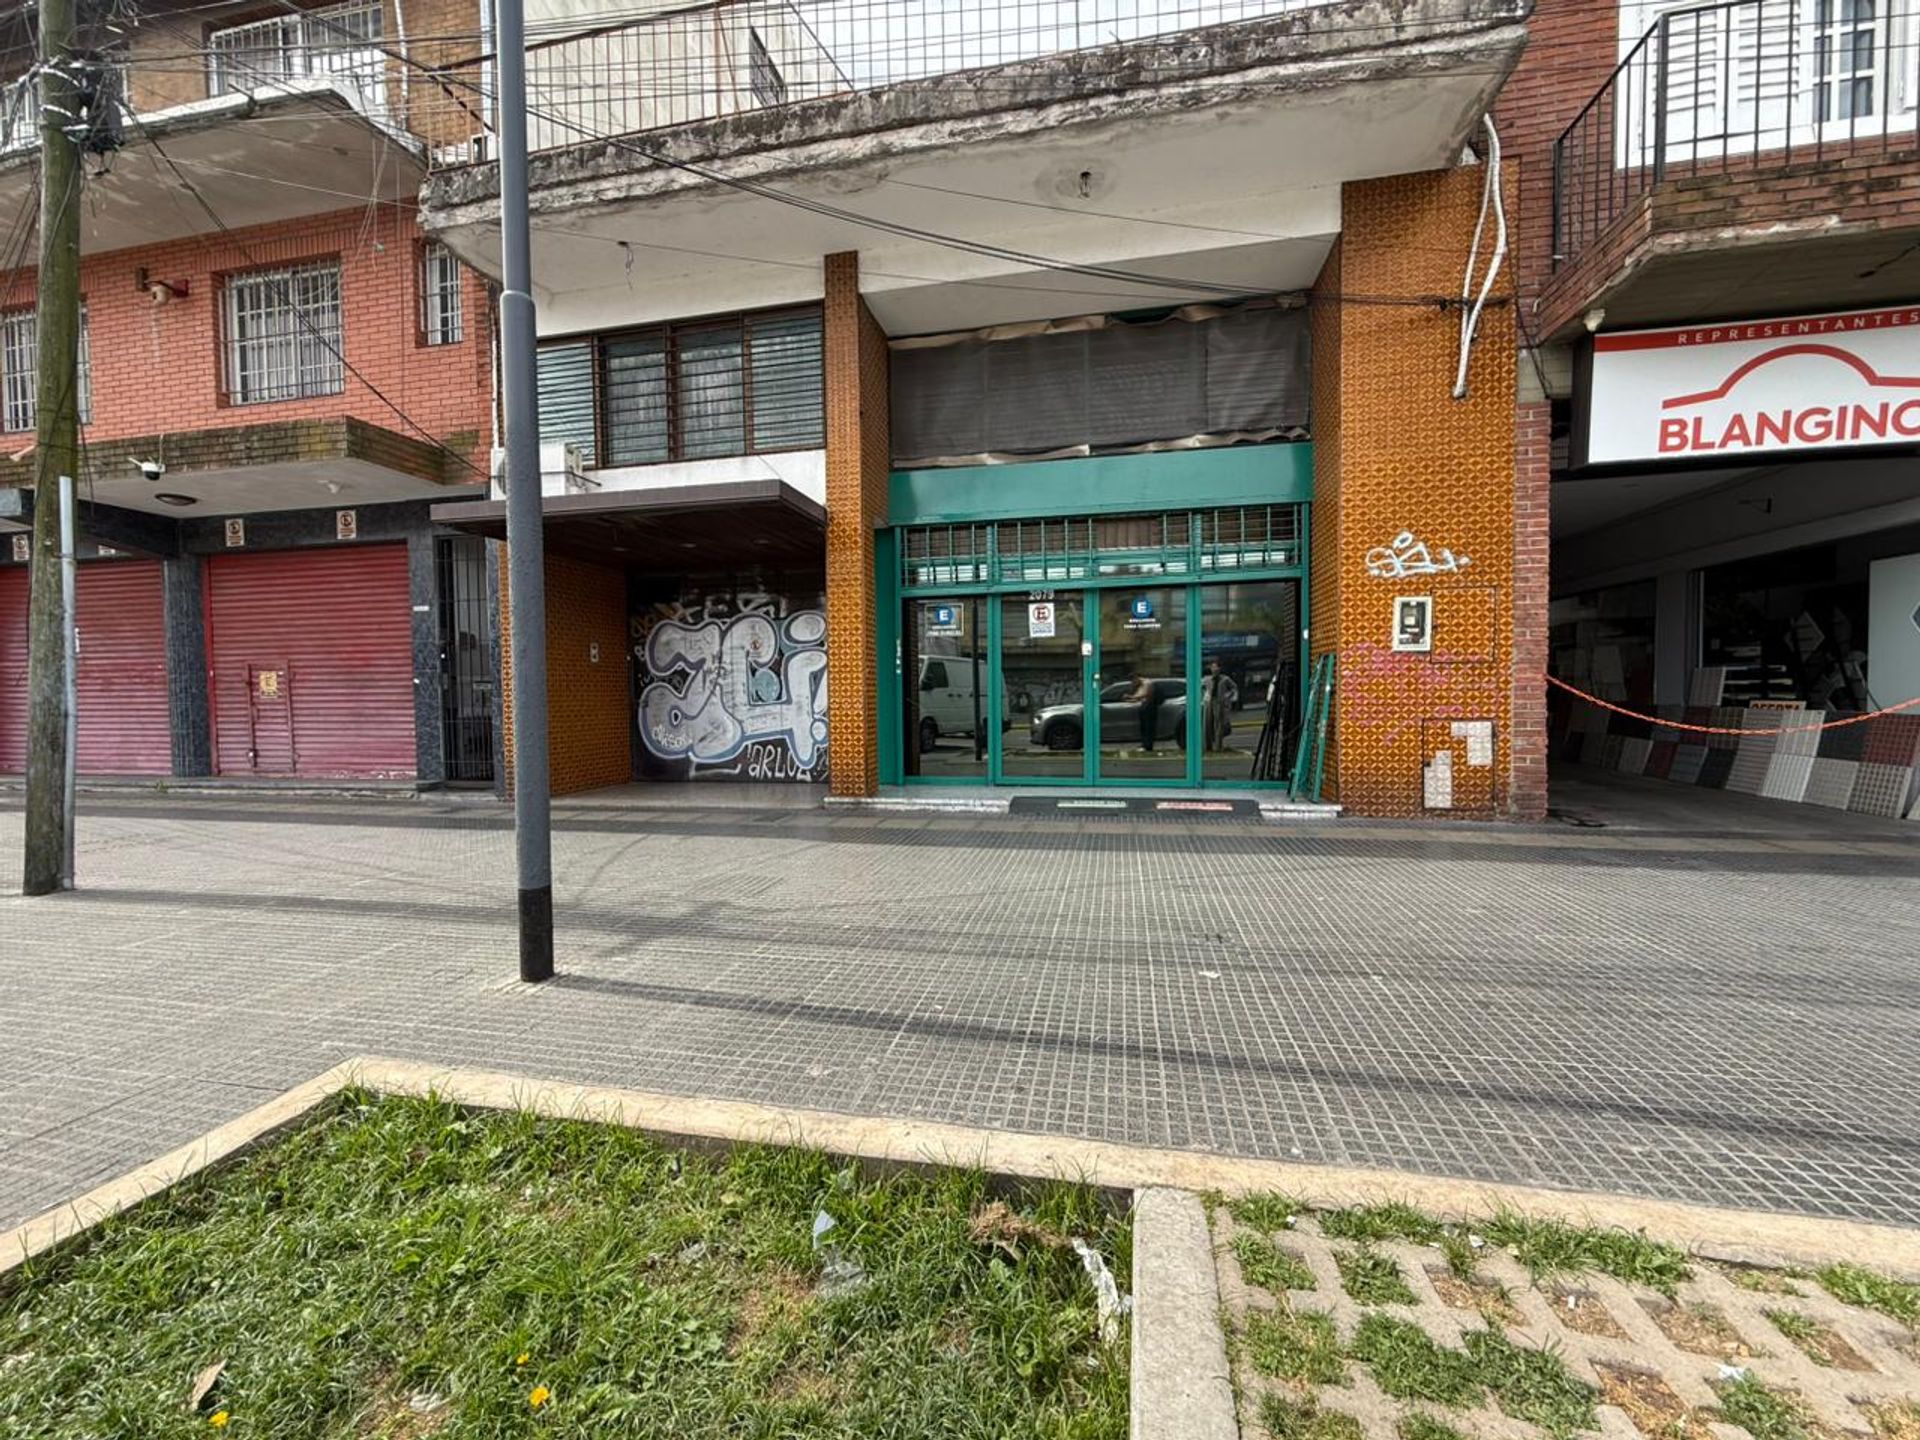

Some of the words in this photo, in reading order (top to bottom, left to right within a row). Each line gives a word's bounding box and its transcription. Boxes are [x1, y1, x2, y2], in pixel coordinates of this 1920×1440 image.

[1677, 311, 1920, 345] REPRESENTANTES
[1137, 601, 1147, 613] E
[939, 609, 950, 621] E
